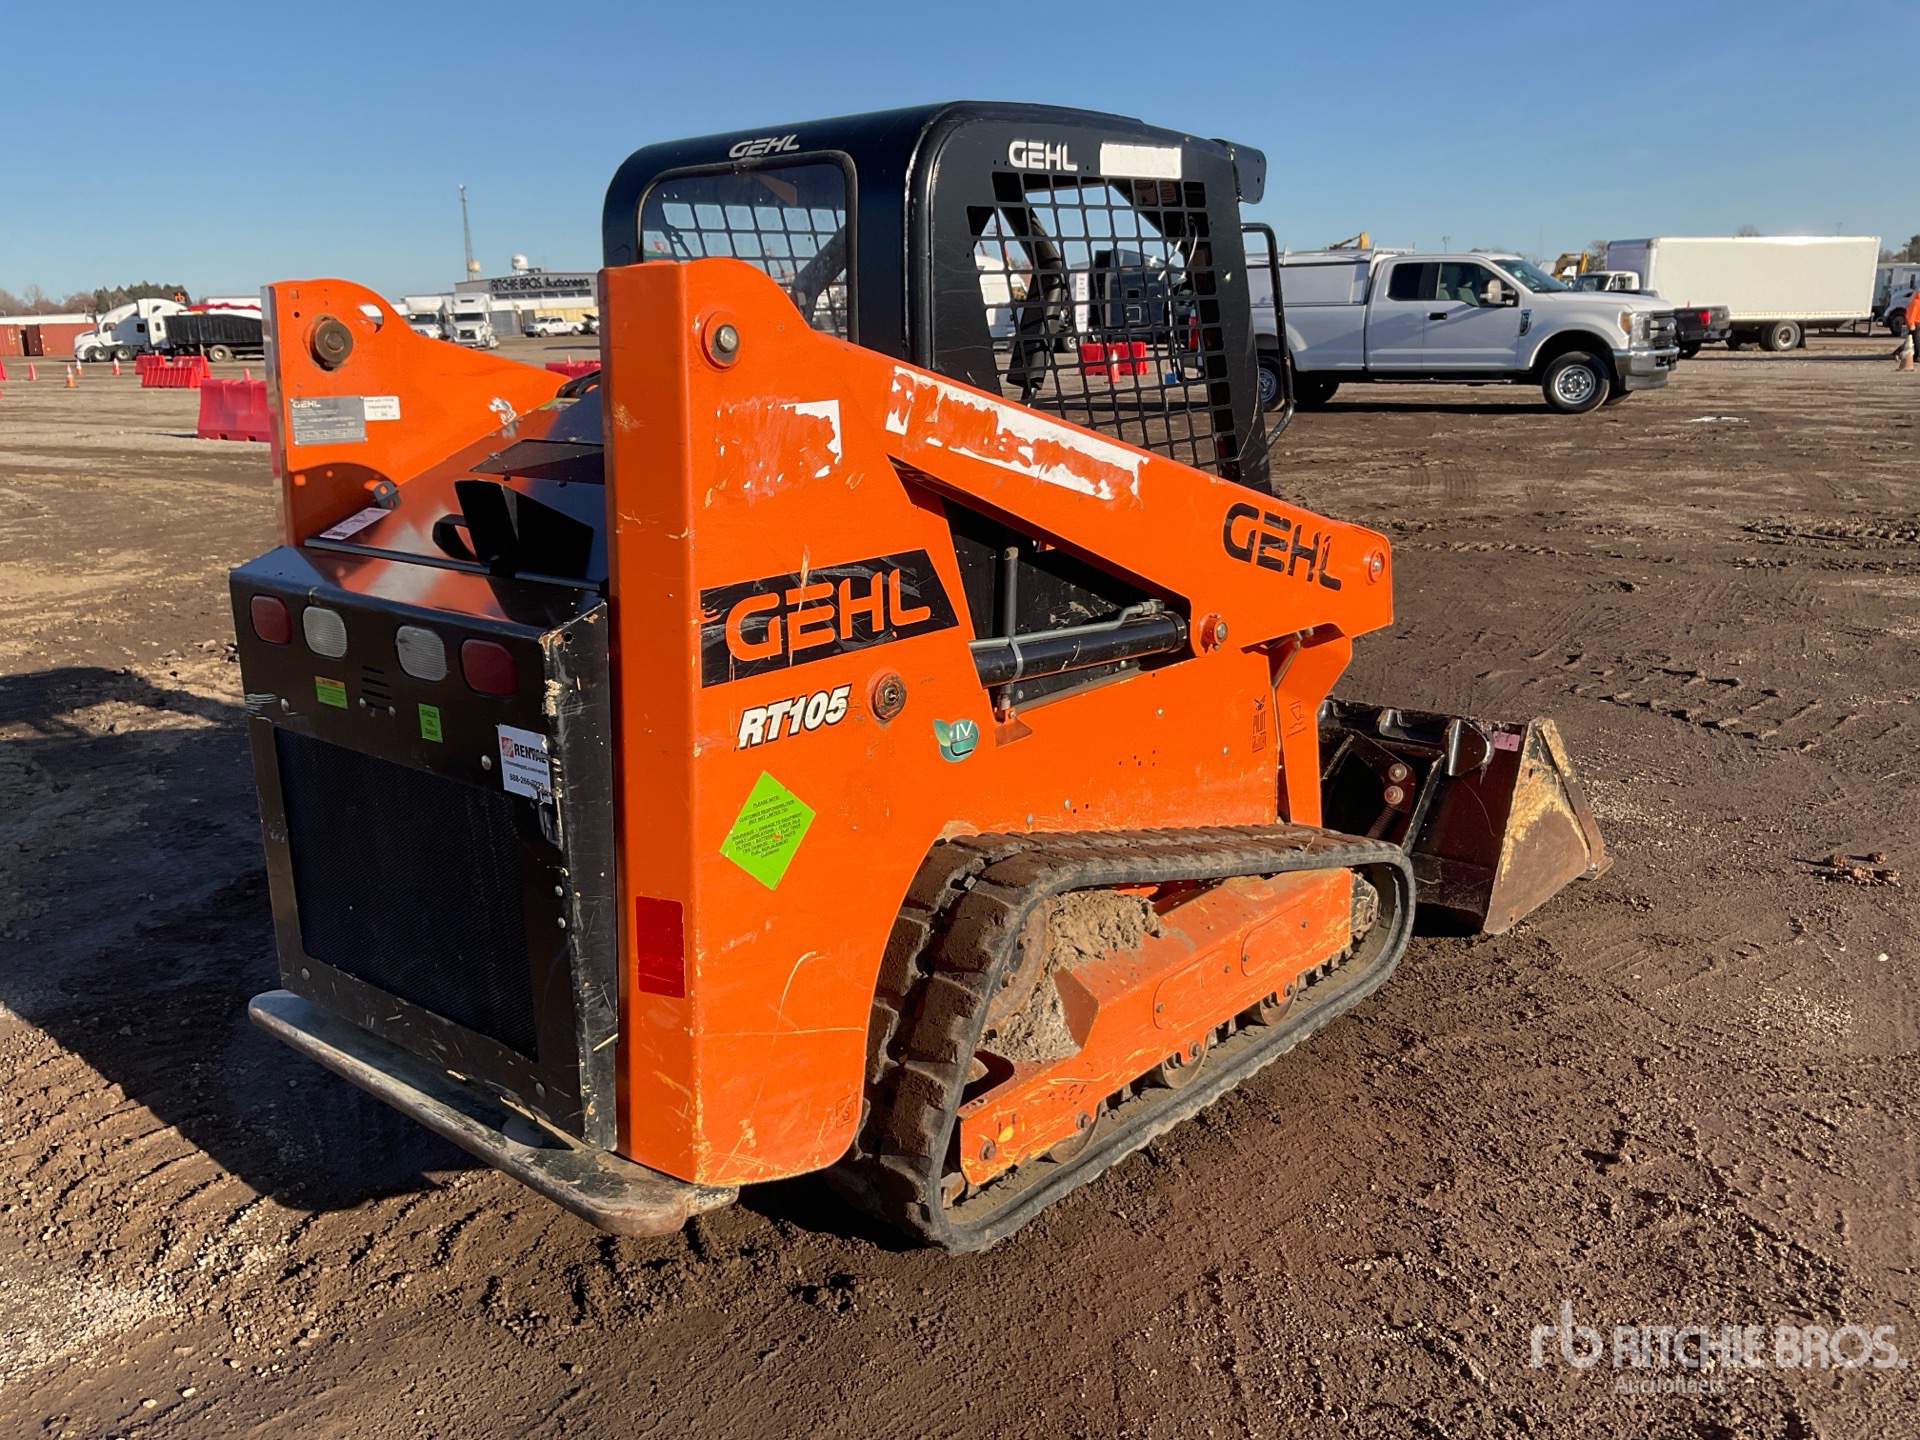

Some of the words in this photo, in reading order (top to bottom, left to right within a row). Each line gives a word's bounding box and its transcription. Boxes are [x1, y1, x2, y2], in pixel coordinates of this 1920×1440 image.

[729, 134, 800, 158] GEHL
[1008, 141, 1078, 171] GEHL
[491, 279, 518, 291] RITCHIE
[545, 277, 590, 288] Auctioneers
[293, 400, 321, 408] GEHL
[1223, 502, 1341, 591] GEHL
[726, 568, 931, 661] GEHL
[738, 684, 852, 750] RT105
